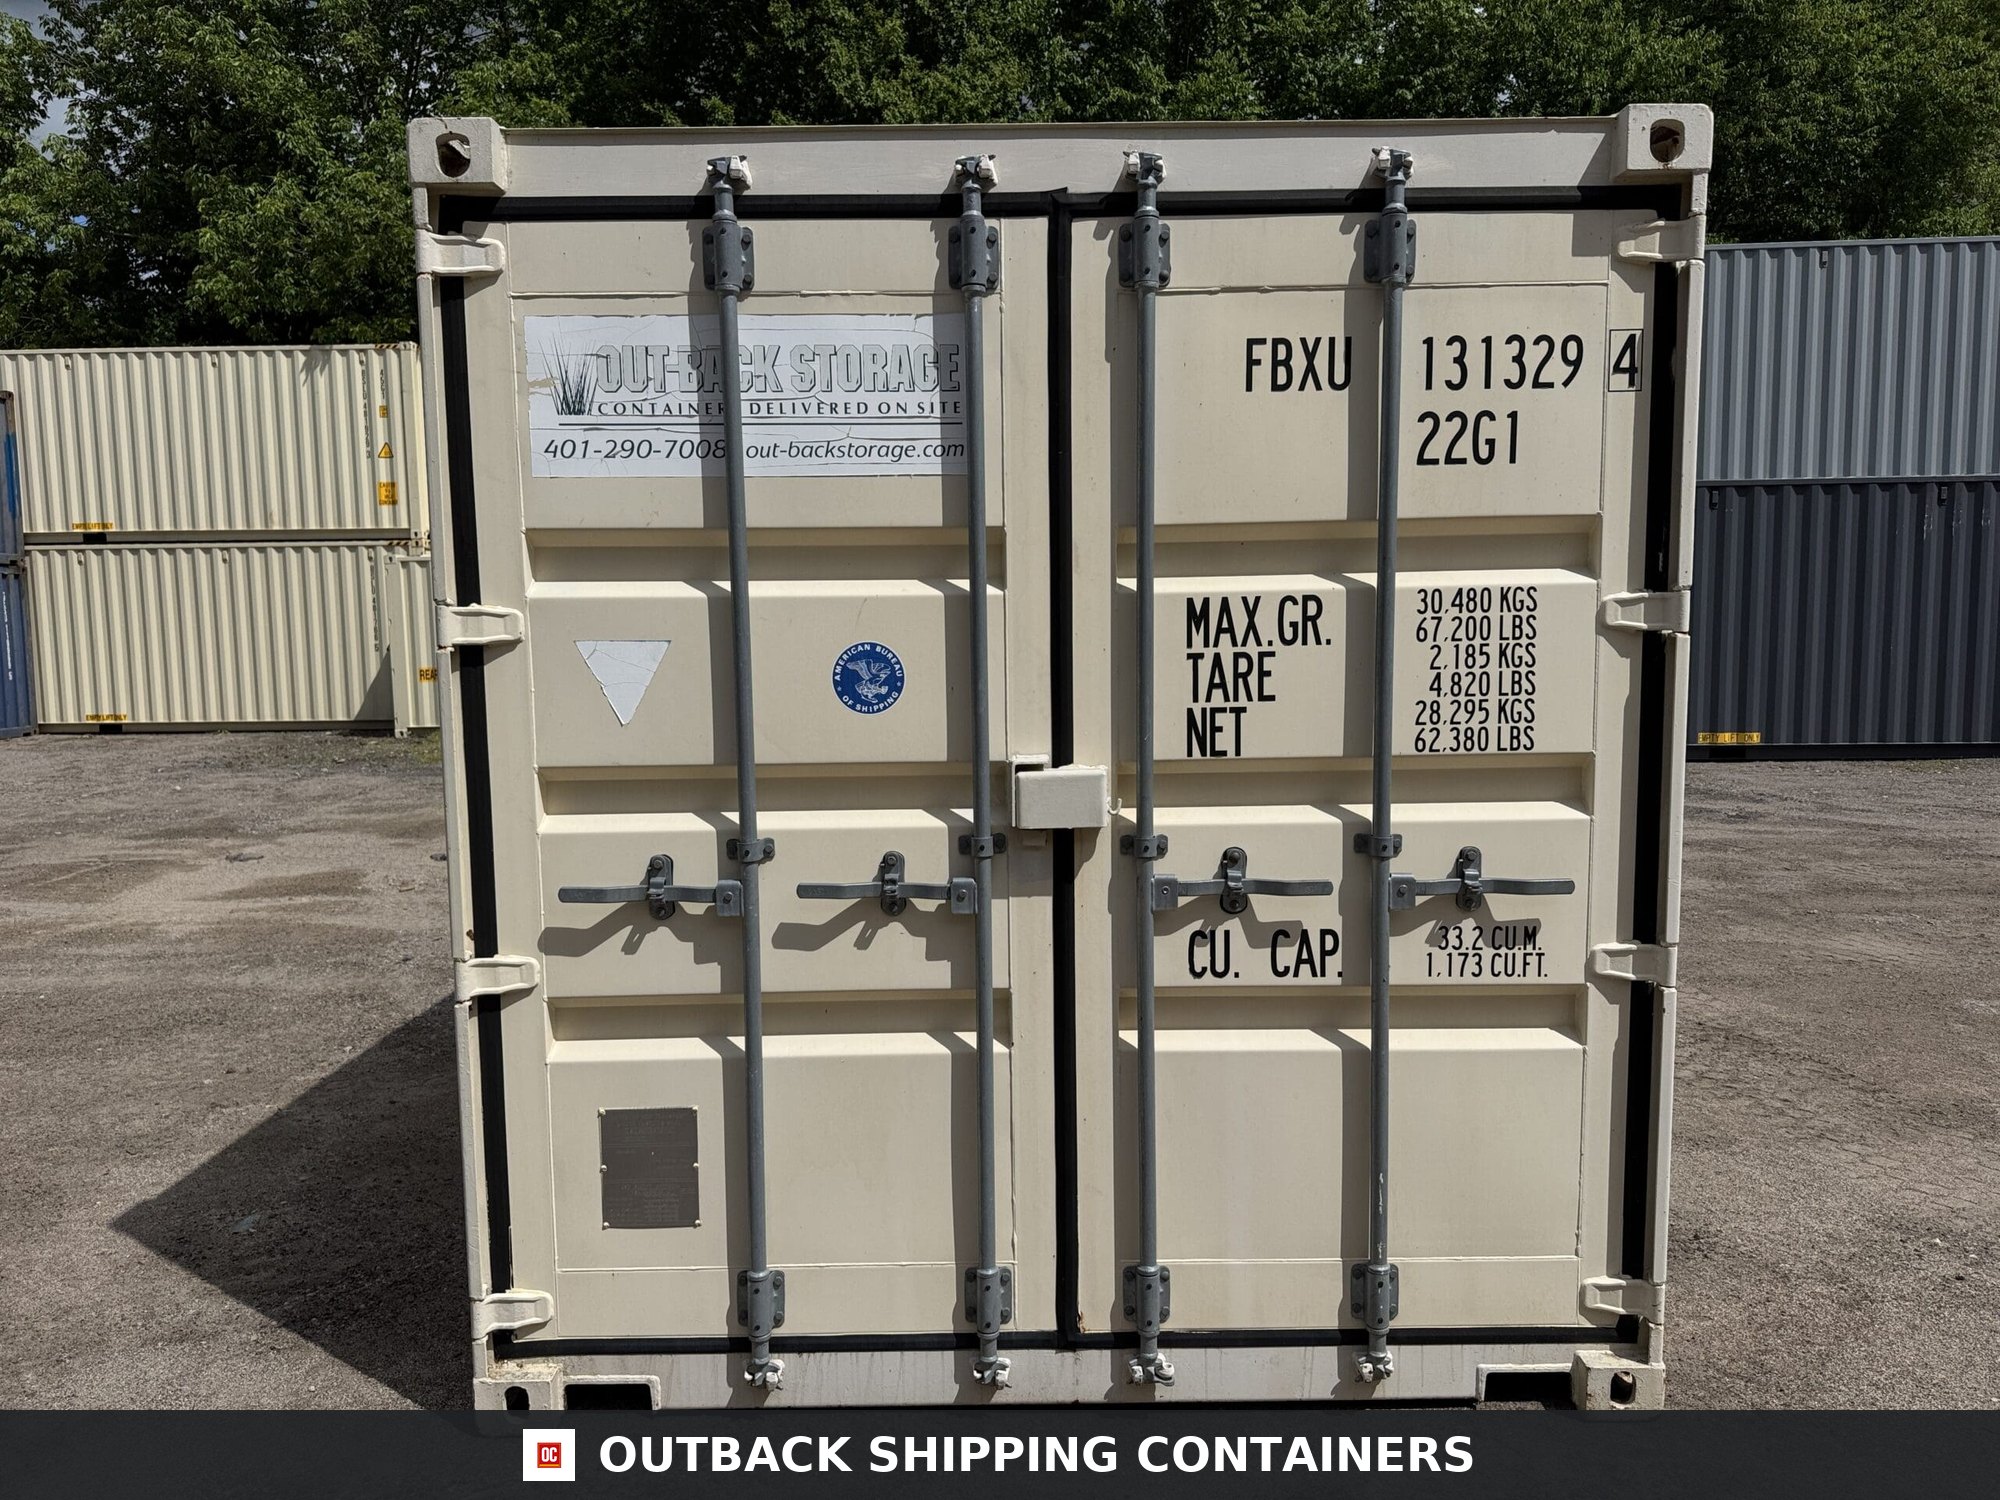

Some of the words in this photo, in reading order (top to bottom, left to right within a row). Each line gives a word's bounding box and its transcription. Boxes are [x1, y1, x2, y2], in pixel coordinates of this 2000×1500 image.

[790, 344, 960, 392] STORAGE
[1245, 336, 1353, 392] FBXU
[1421, 334, 1584, 391] 131329
[1611, 333, 1639, 388] 4
[750, 402, 868, 414] DELIVERED
[878, 402, 907, 414] ON
[917, 402, 961, 414] SITE
[544, 438, 726, 459] 401-290-7008
[746, 441, 965, 462] out-backstorage.com
[1416, 410, 1518, 466] 22G1
[1417, 588, 1492, 614] 30,480
[1500, 586, 1537, 613] KGS
[1186, 594, 1332, 649] MAX.GR.
[1416, 615, 1491, 642] 67,200
[1500, 614, 1537, 640] LBS
[834, 643, 871, 681] AMERICAN
[875, 645, 903, 677] BUREAU
[1430, 643, 1490, 670] 2,185
[1499, 642, 1536, 669] KGS
[1186, 650, 1276, 704] TARE
[1429, 671, 1491, 698] 4,820
[1499, 670, 1536, 696] LBS
[842, 695, 854, 706] OF
[855, 691, 899, 712] SHIPPING
[1415, 699, 1490, 726] 28,295
[1498, 698, 1535, 724] KGS
[1186, 706, 1248, 757] NET
[1414, 726, 1489, 753] 62,380
[1497, 725, 1535, 751] LBS
[1438, 926, 1483, 951] 33.2
[1491, 925, 1542, 951] CU.M.
[1187, 930, 1240, 978] CU.
[1270, 928, 1343, 978] CAP.
[1427, 952, 1483, 977] 1,173
[1490, 952, 1548, 977] CU.FT.
